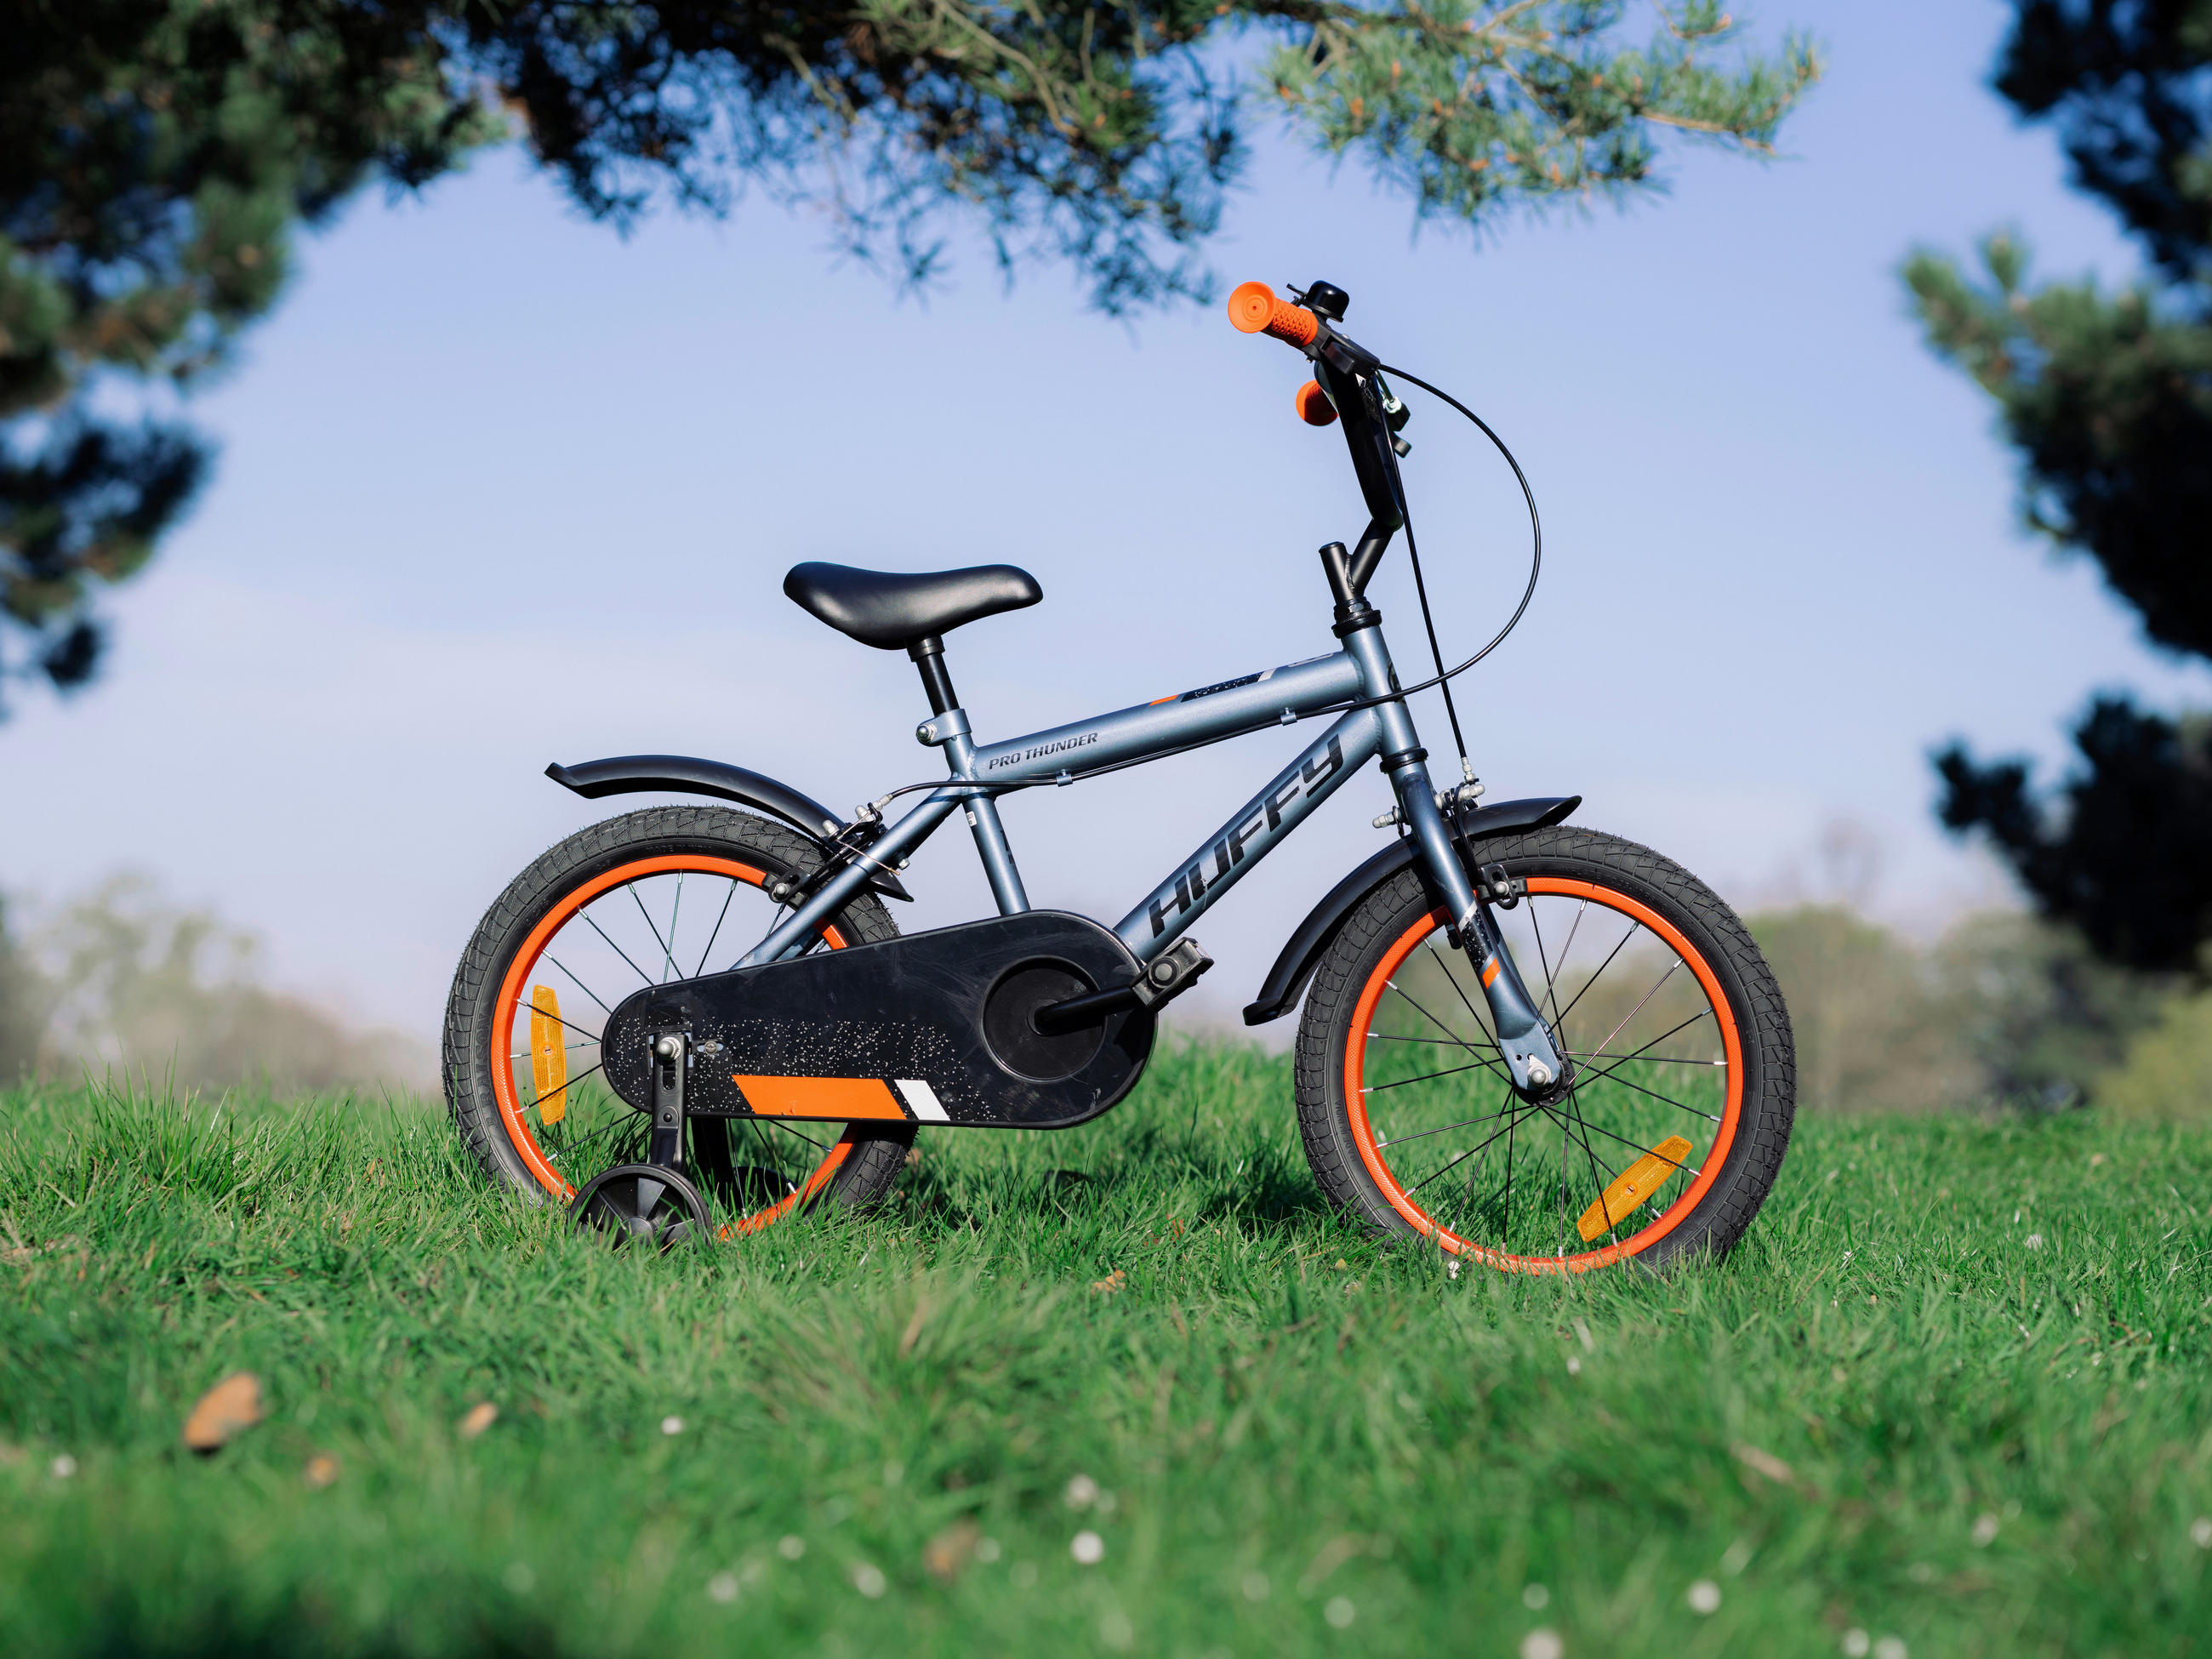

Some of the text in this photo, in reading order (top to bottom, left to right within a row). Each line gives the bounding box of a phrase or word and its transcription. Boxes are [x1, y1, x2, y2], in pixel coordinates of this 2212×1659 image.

[989, 733, 1098, 770] PRO THUNDER
[1149, 733, 1344, 938] HUFFY
[476, 1013, 493, 1108] RALSON
[1335, 1100, 1345, 1124] INDIA
